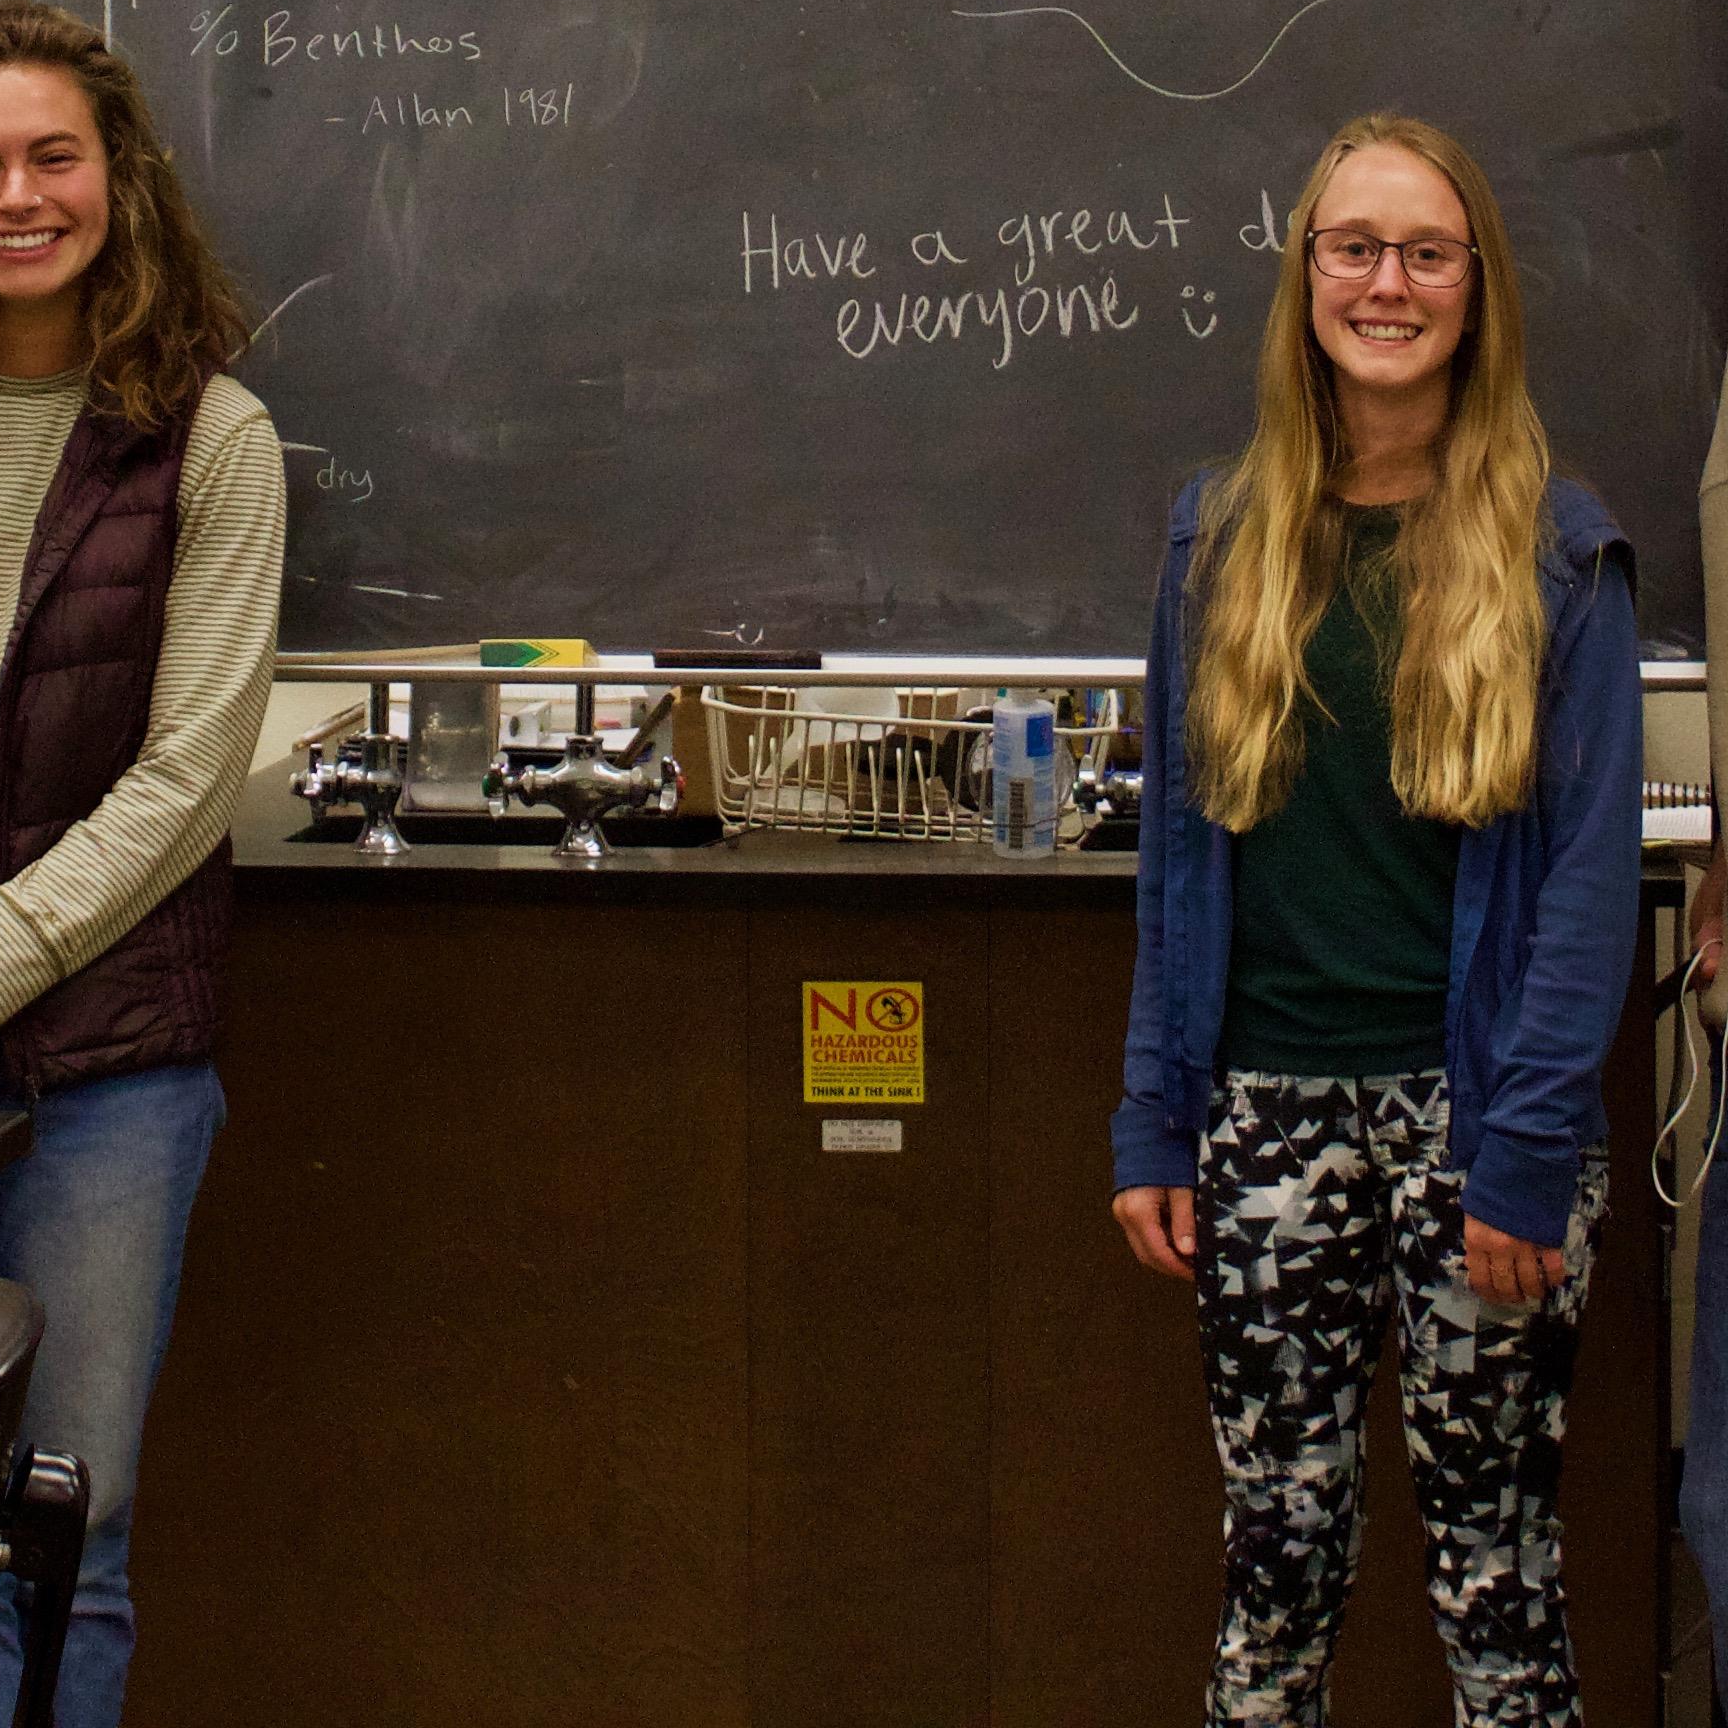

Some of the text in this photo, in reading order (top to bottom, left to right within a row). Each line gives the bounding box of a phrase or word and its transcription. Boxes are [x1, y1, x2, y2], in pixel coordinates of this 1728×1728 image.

[263, 9, 482, 66] Benthos
[362, 92, 474, 134] Allan
[503, 82, 573, 127] 1981
[741, 210, 876, 293] Have
[911, 229, 968, 266] a
[999, 192, 1191, 286] great
[836, 274, 1139, 370] everyone
[317, 457, 374, 503] dry
[810, 987, 920, 1033] NO
[810, 1034, 918, 1049] HAZARDOUS
[812, 1049, 917, 1064] CHEMICALS
[812, 1086, 845, 1097] THINK
[848, 1086, 861, 1097] AT
[864, 1086, 885, 1097] THE
